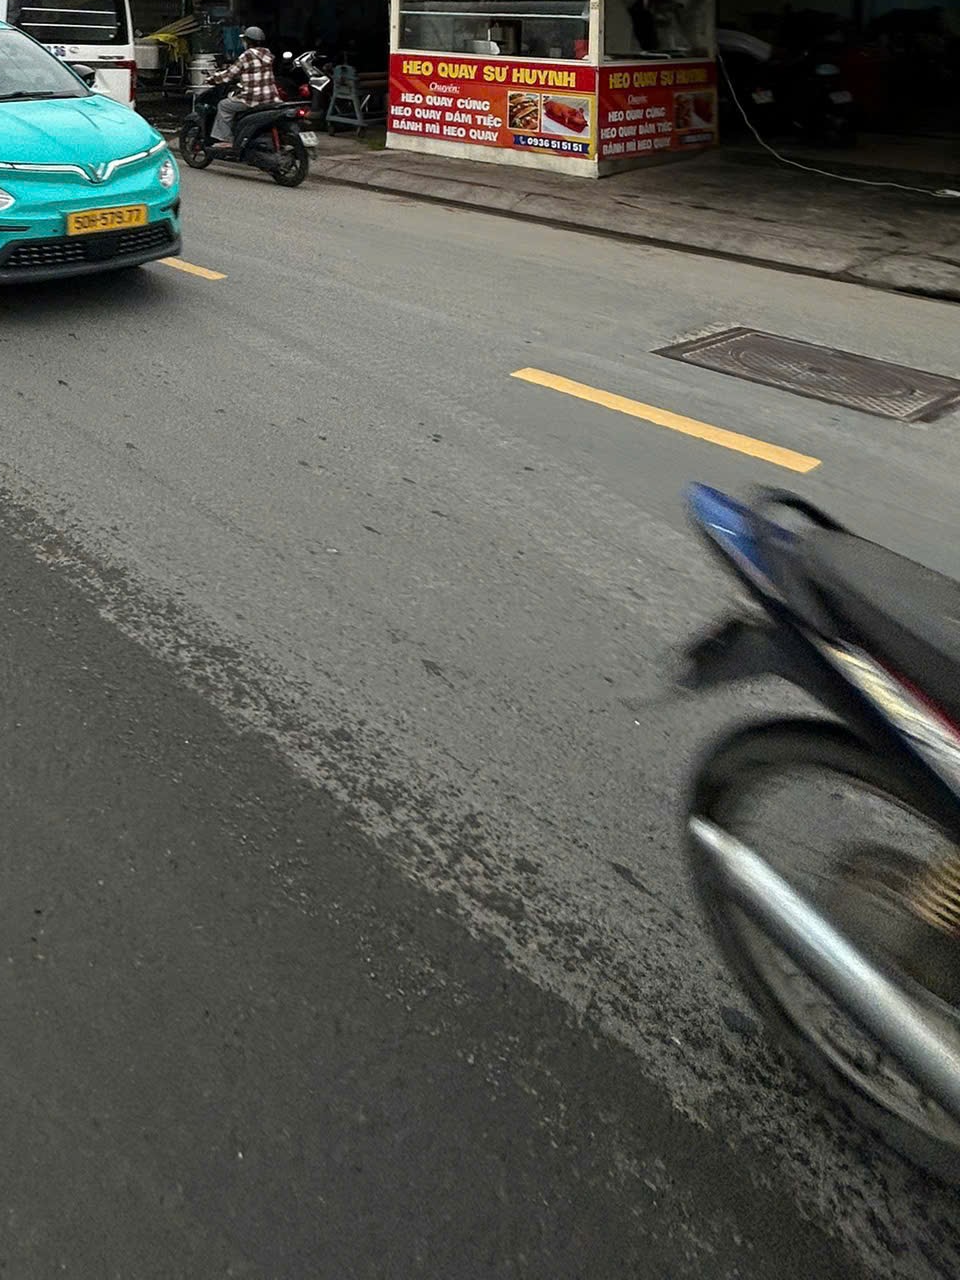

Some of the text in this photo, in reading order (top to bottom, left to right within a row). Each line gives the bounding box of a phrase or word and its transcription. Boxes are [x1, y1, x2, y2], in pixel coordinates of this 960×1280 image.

[402, 60, 576, 88] HEO QUAY SƯ HUYNH
[609, 72, 630, 89] HEO
[633, 71, 657, 87] QUAY
[401, 92, 423, 104] HEO
[426, 95, 453, 107] QUAY
[390, 106, 412, 117] HEO
[415, 108, 441, 121] QUAY
[608, 110, 624, 122] HEO
[393, 118, 498, 142] BÁNH MÌ HEO QUAY
[600, 127, 617, 139] HEO
[527, 137, 582, 152] 0936 51 51 51
[638, 138, 652, 151] HEO
